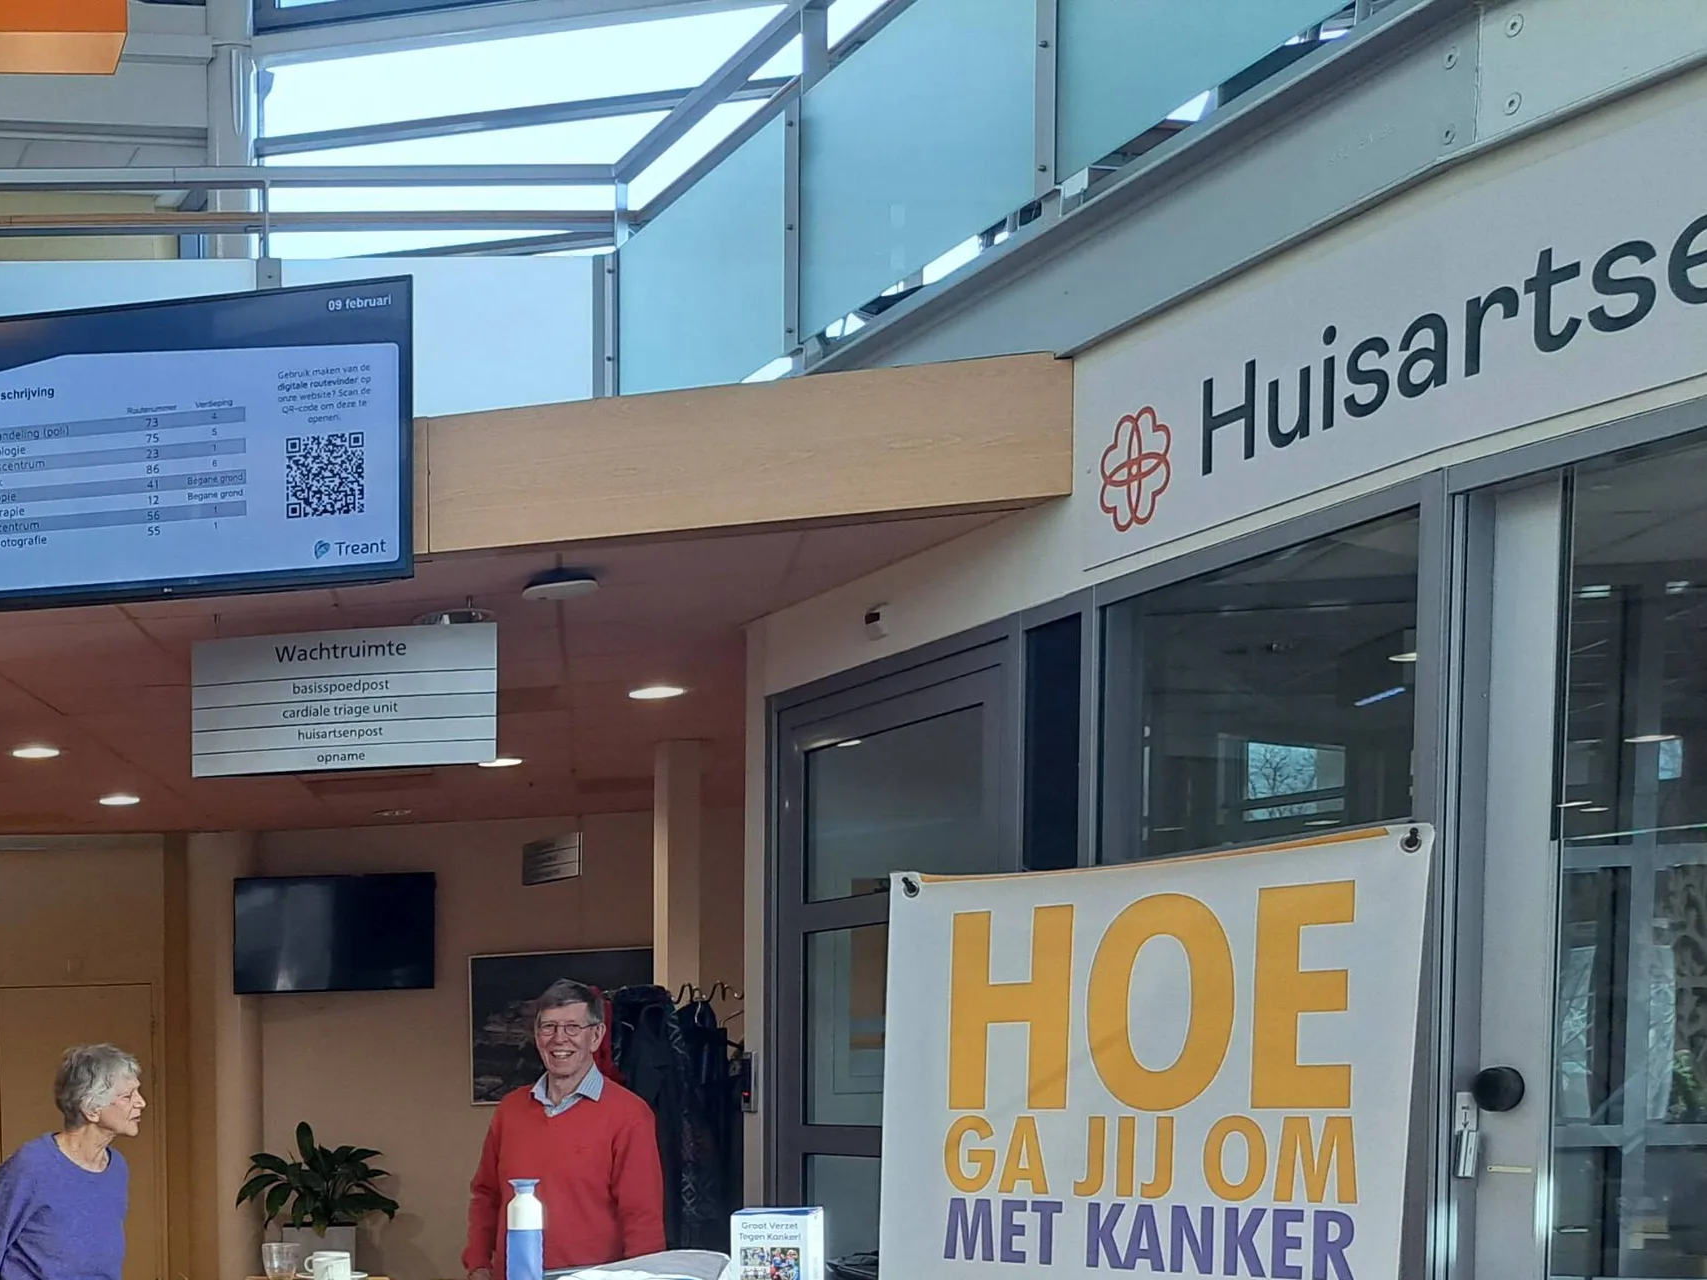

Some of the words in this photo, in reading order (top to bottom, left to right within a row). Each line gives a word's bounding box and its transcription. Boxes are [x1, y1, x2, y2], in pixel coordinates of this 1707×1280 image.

[328, 298, 342, 311] 09
[344, 294, 392, 309] februari
[278, 370, 310, 379] Gebruik
[313, 367, 340, 376] maken
[278, 381, 308, 392] digitale
[310, 377, 358, 388] routevinder
[360, 376, 371, 384] op
[300, 390, 336, 400] website?
[338, 389, 358, 397] Scan
[360, 387, 371, 395] de
[282, 404, 318, 414] QR-code
[320, 403, 334, 411] om
[336, 401, 356, 409] deze
[358, 399, 367, 407] te
[145, 418, 159, 428] 73
[146, 434, 159, 443] 75
[212, 428, 217, 436] 5
[146, 449, 159, 459] 23
[146, 465, 159, 474] 86
[147, 480, 159, 489] 41
[187, 476, 218, 486] Begane
[220, 473, 243, 484] grond
[148, 496, 159, 505] 12
[188, 491, 218, 501] Begane
[220, 489, 243, 499] grond
[147, 511, 160, 520] 56
[148, 526, 161, 536] 55
[336, 539, 386, 557] Treant
[275, 640, 407, 663] Wachtruimte
[292, 678, 390, 697] basisspoedpost
[282, 704, 331, 720] cardiale
[334, 703, 370, 718] triage
[373, 701, 398, 714] unit
[297, 725, 384, 742] huisartsenpost
[317, 751, 366, 764] opname
[947, 879, 1356, 1112] HOE
[943, 1115, 1050, 1195] GA
[1073, 1115, 1175, 1199] JIJ
[1202, 1114, 1359, 1204] OM
[741, 1222, 767, 1230] Groot
[769, 1222, 798, 1230] Verzet
[943, 1197, 1063, 1265] MET
[739, 1233, 765, 1242] Tegen
